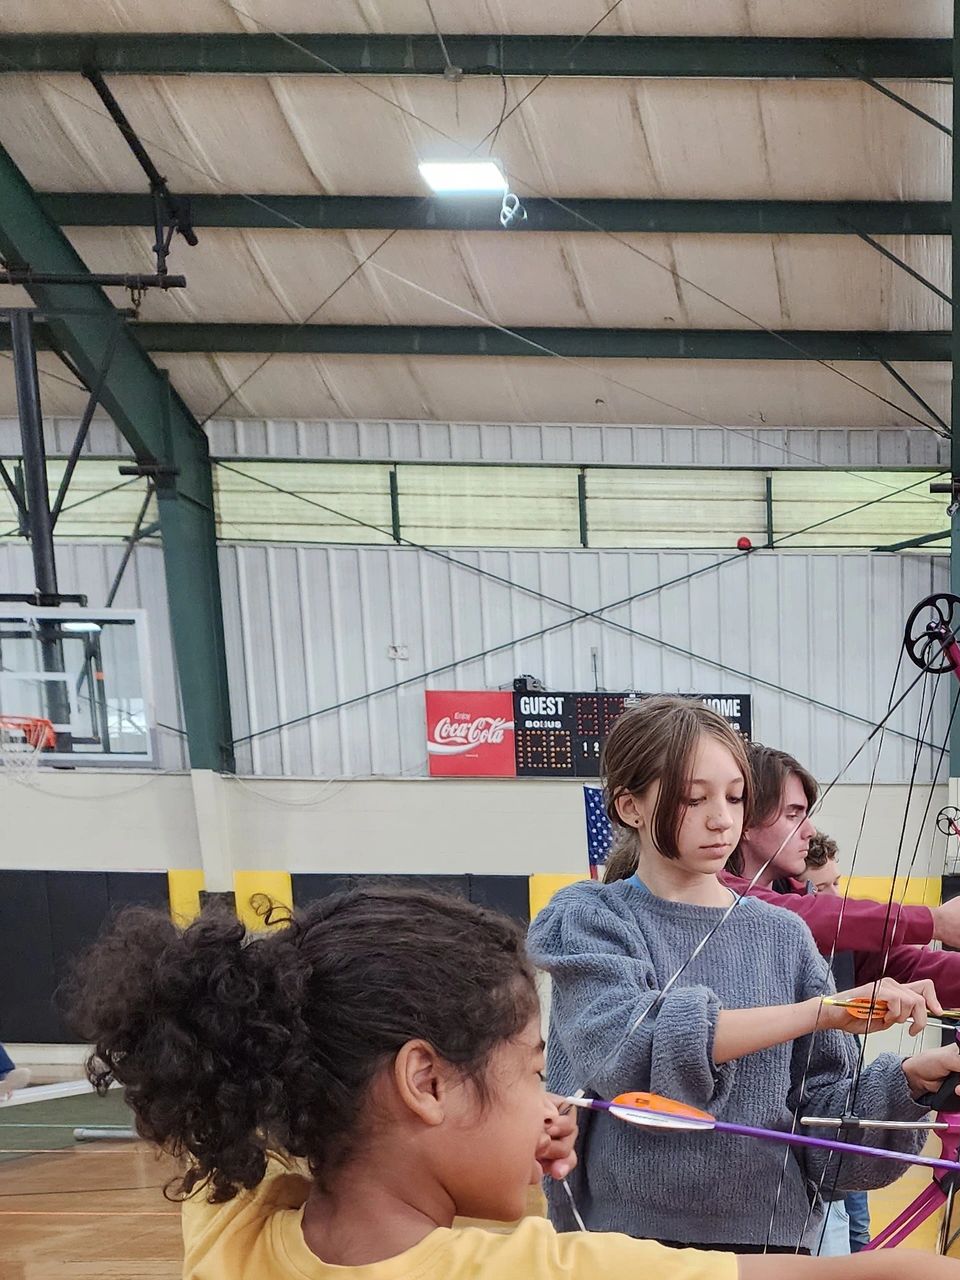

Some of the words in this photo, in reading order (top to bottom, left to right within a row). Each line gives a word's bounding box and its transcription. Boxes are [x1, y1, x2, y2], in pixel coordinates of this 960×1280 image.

[520, 696, 564, 715] GUEST
[434, 716, 506, 743] Coca-Cola
[525, 720, 561, 729] BONUS
